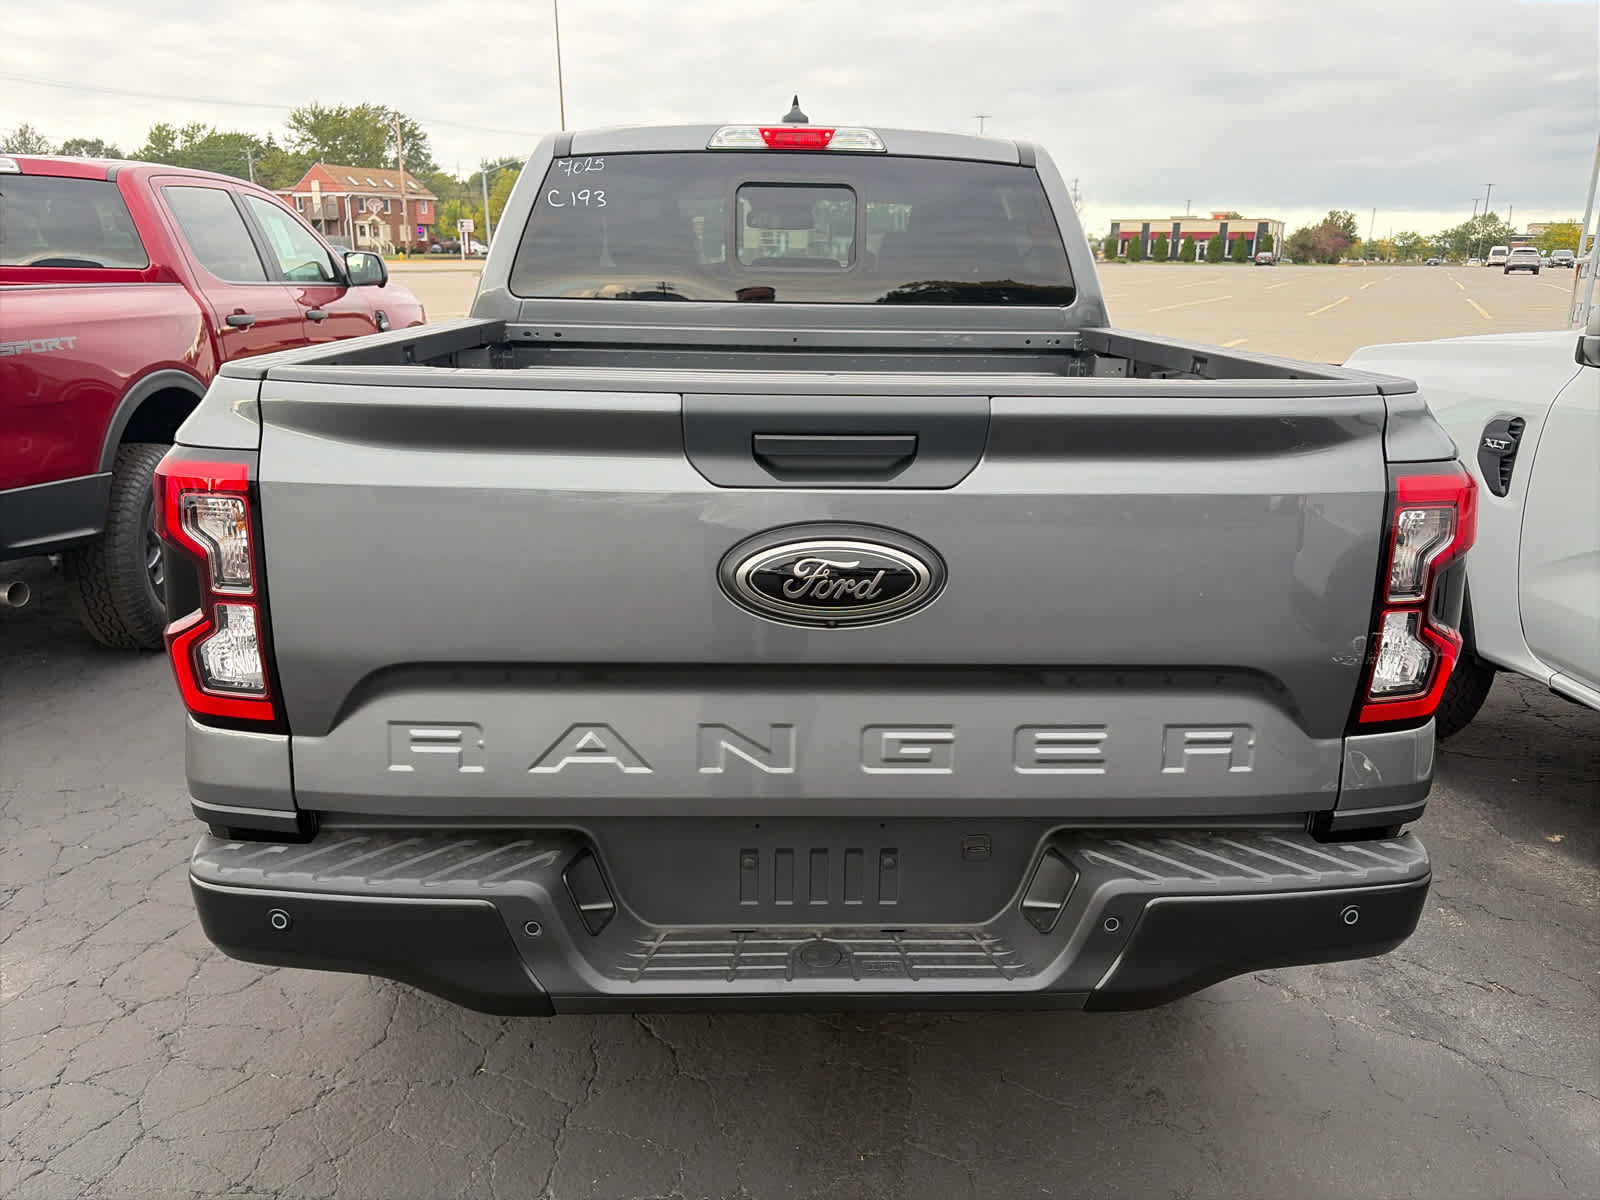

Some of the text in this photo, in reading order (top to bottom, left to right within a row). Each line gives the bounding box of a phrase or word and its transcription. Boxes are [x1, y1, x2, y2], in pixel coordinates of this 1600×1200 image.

[0, 336, 77, 357] SPORT
[1483, 437, 1511, 449] XLT
[783, 557, 886, 600] Ford
[386, 720, 1255, 776] RANGER
